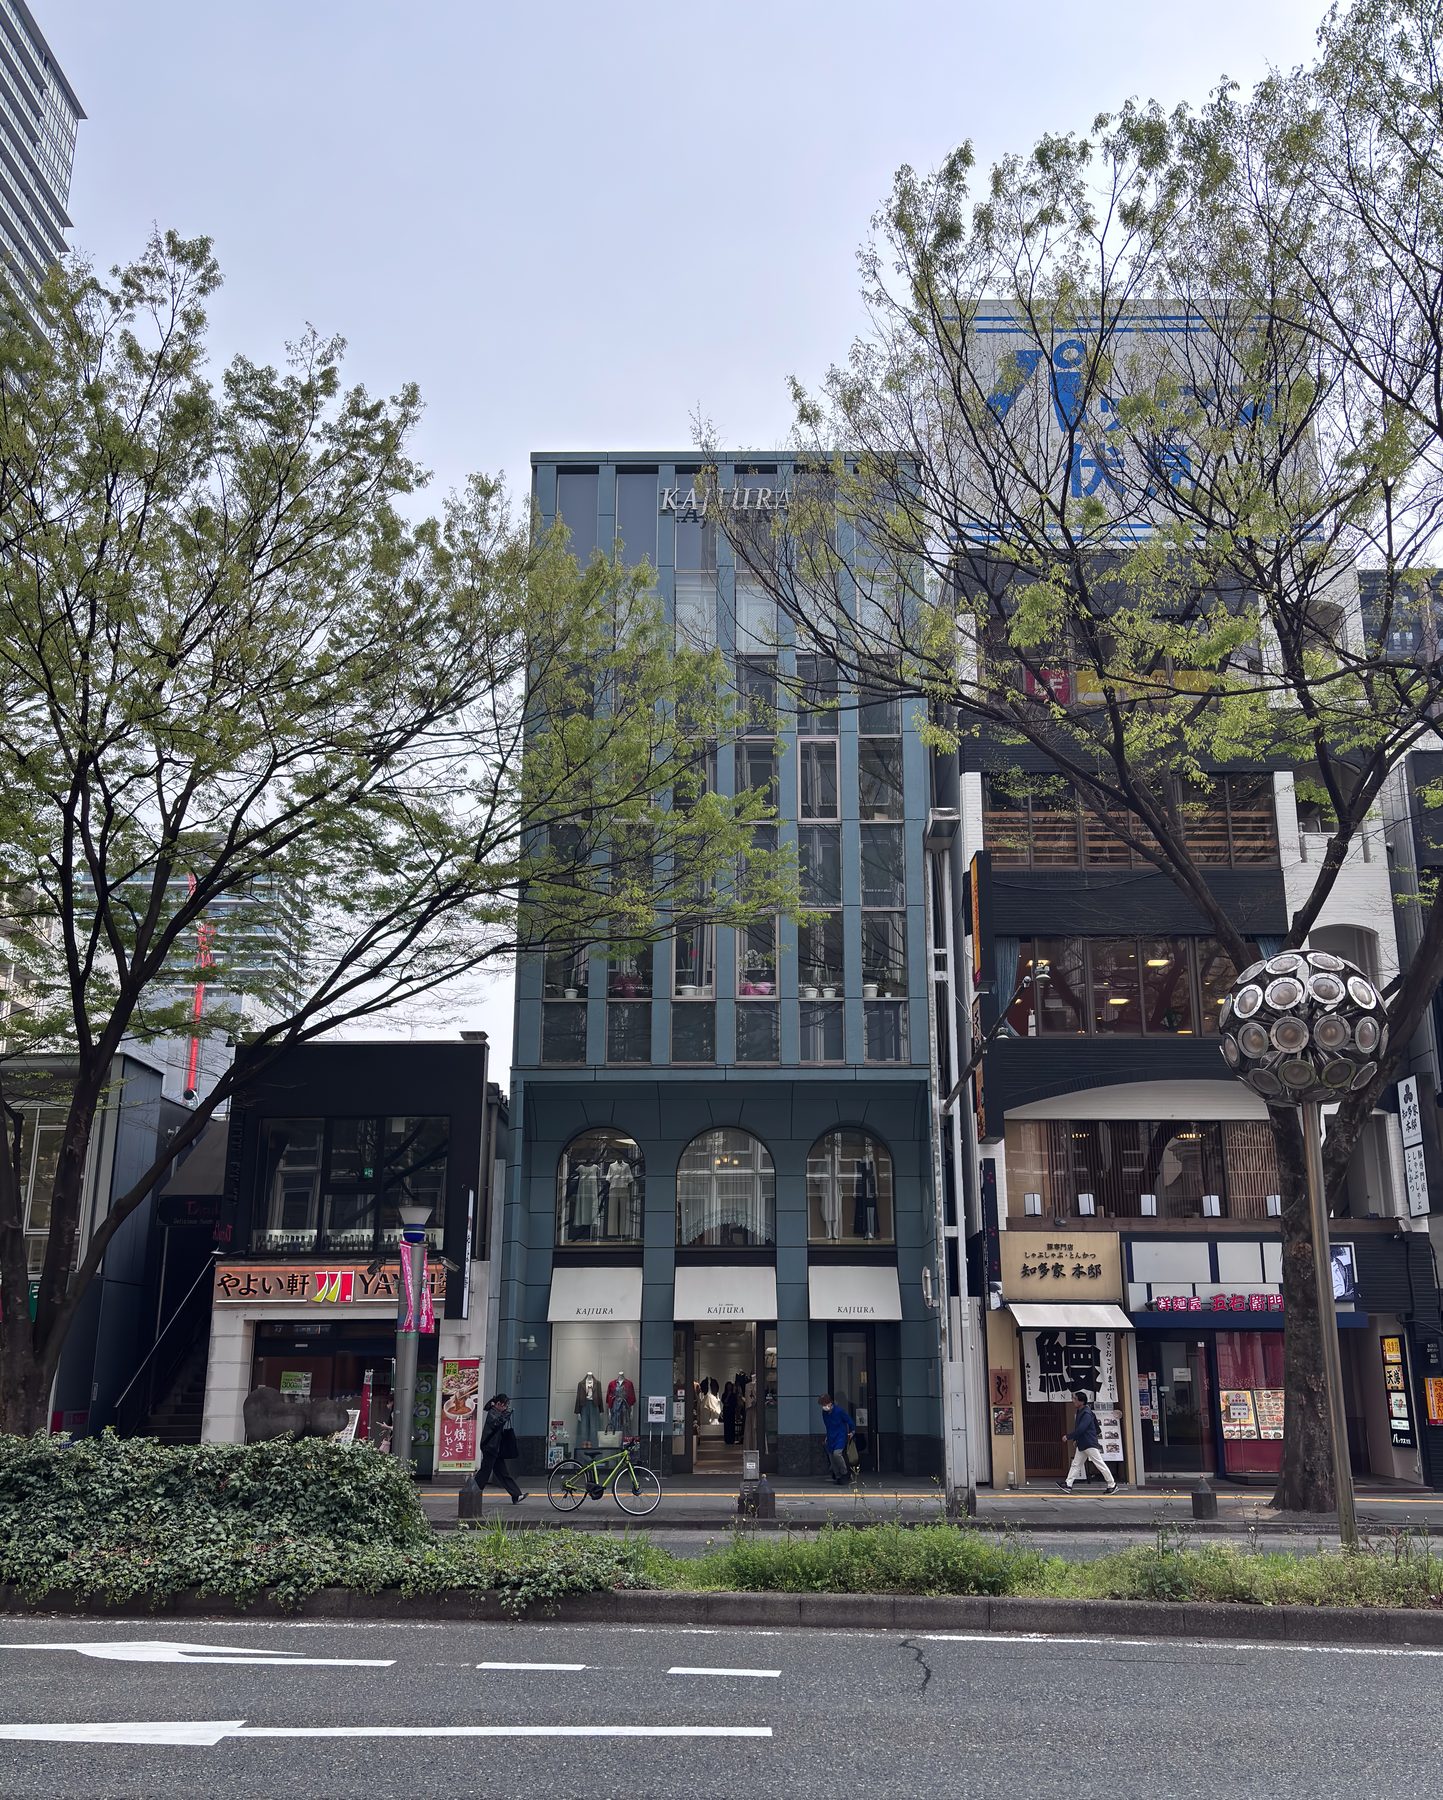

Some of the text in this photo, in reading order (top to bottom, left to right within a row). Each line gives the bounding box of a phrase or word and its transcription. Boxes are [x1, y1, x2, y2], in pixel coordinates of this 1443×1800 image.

[661, 487, 790, 516] KAJIURA
[1021, 1262, 1102, 1280] 知多家 本邸
[216, 1273, 310, 1296] やよい軒
[576, 1307, 614, 1316] KAJIURA
[707, 1306, 745, 1315] KAJIURA
[837, 1306, 875, 1314] KAJIURA
[1210, 1293, 1284, 1312] 五右衛門
[442, 1425, 454, 1458] しゃぶ
[454, 1414, 467, 1453] 牛焼き
